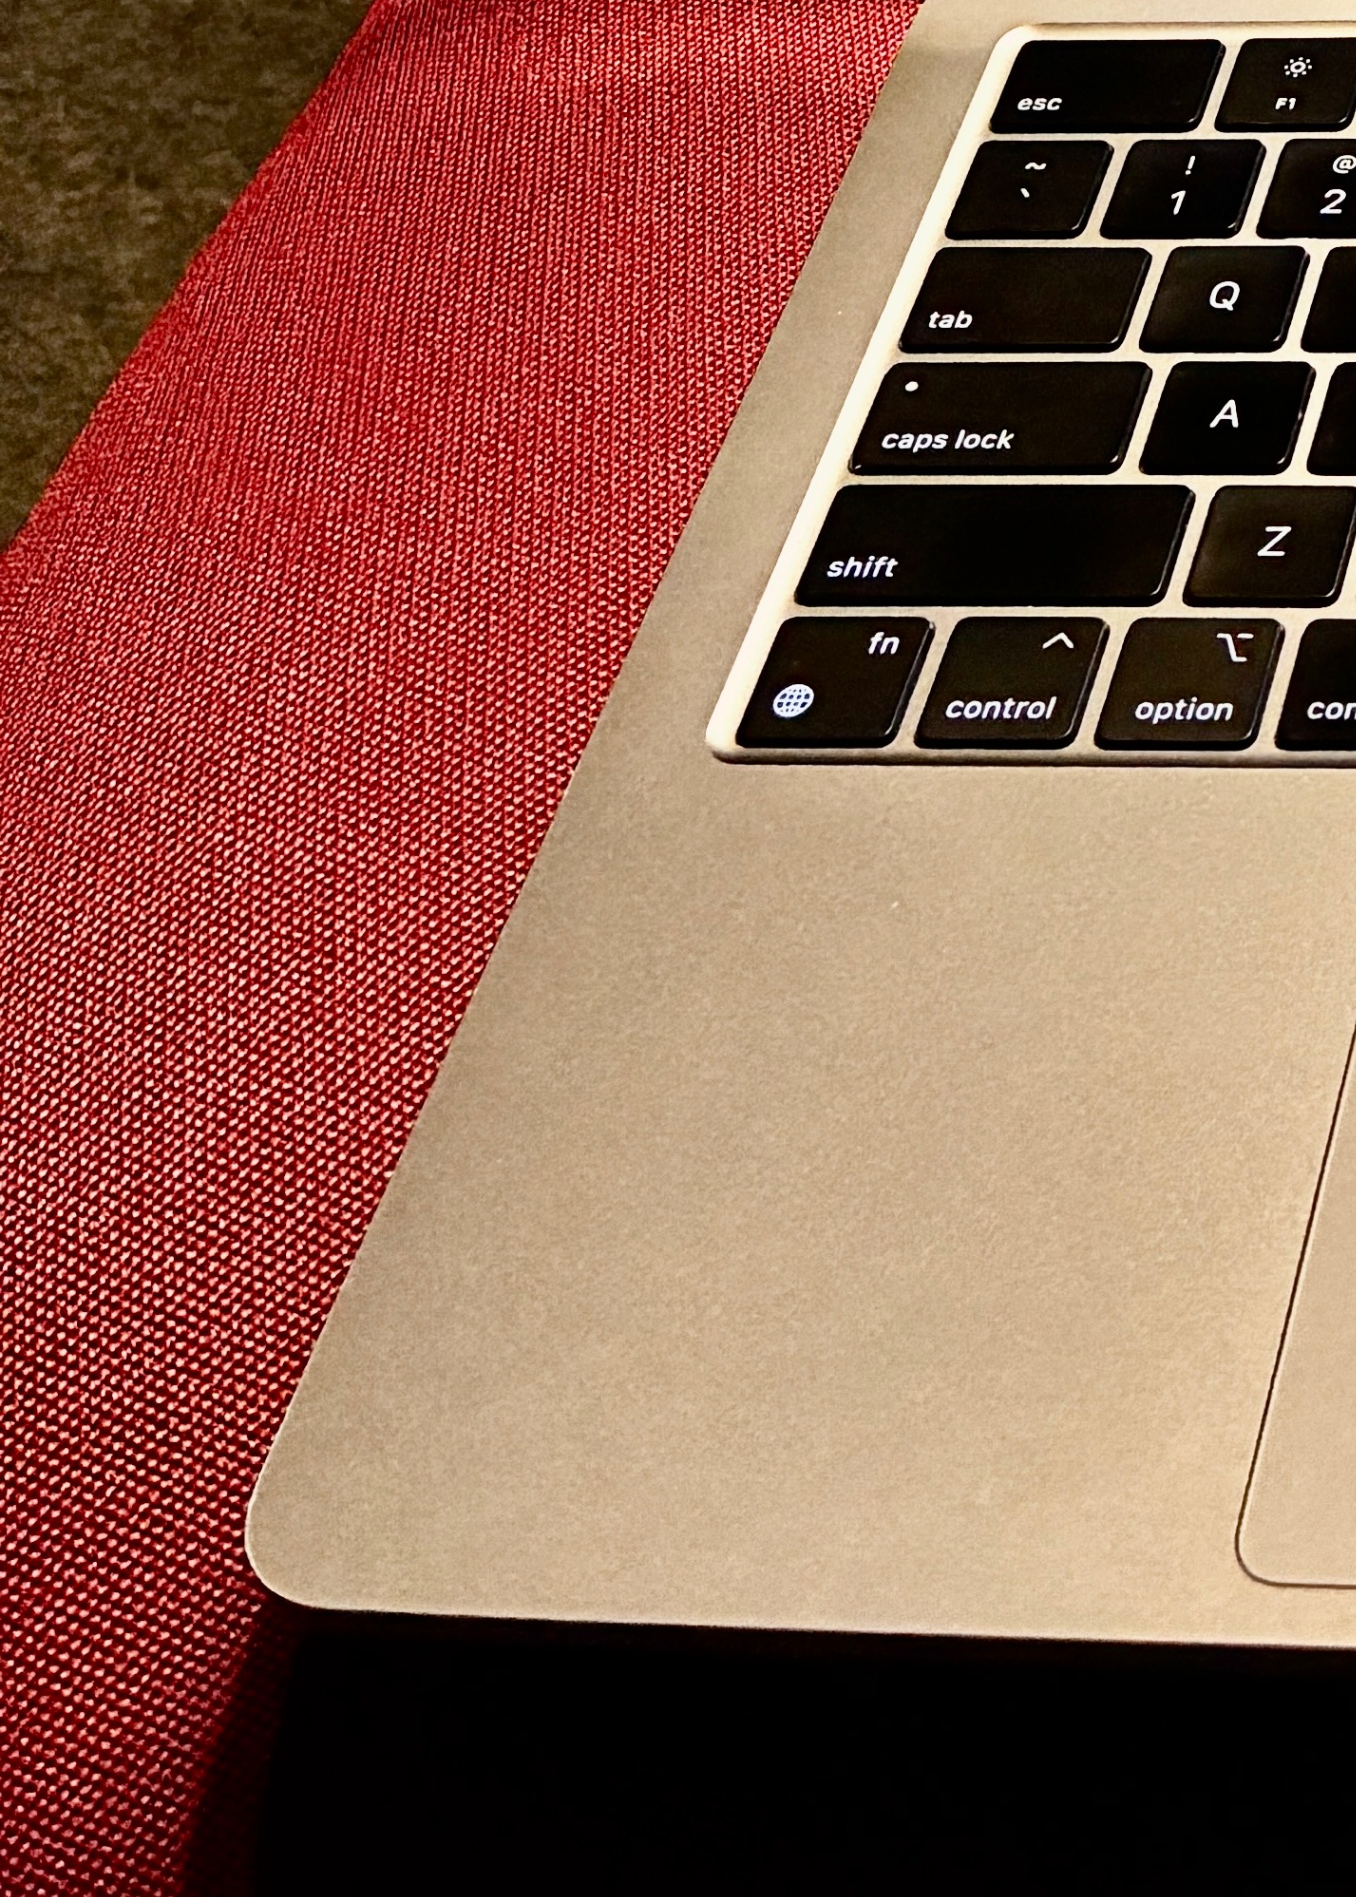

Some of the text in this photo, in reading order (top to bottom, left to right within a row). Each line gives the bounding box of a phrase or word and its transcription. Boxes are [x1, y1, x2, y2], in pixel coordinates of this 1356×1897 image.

[1017, 97, 1063, 111] esc
[1209, 280, 1241, 311] Q
[928, 310, 973, 329] tab
[1209, 399, 1239, 428] A
[881, 429, 1015, 453] caps lock
[826, 555, 899, 578] shift
[868, 631, 900, 655] fn
[945, 696, 1057, 720] control
[1134, 696, 1234, 725] option
